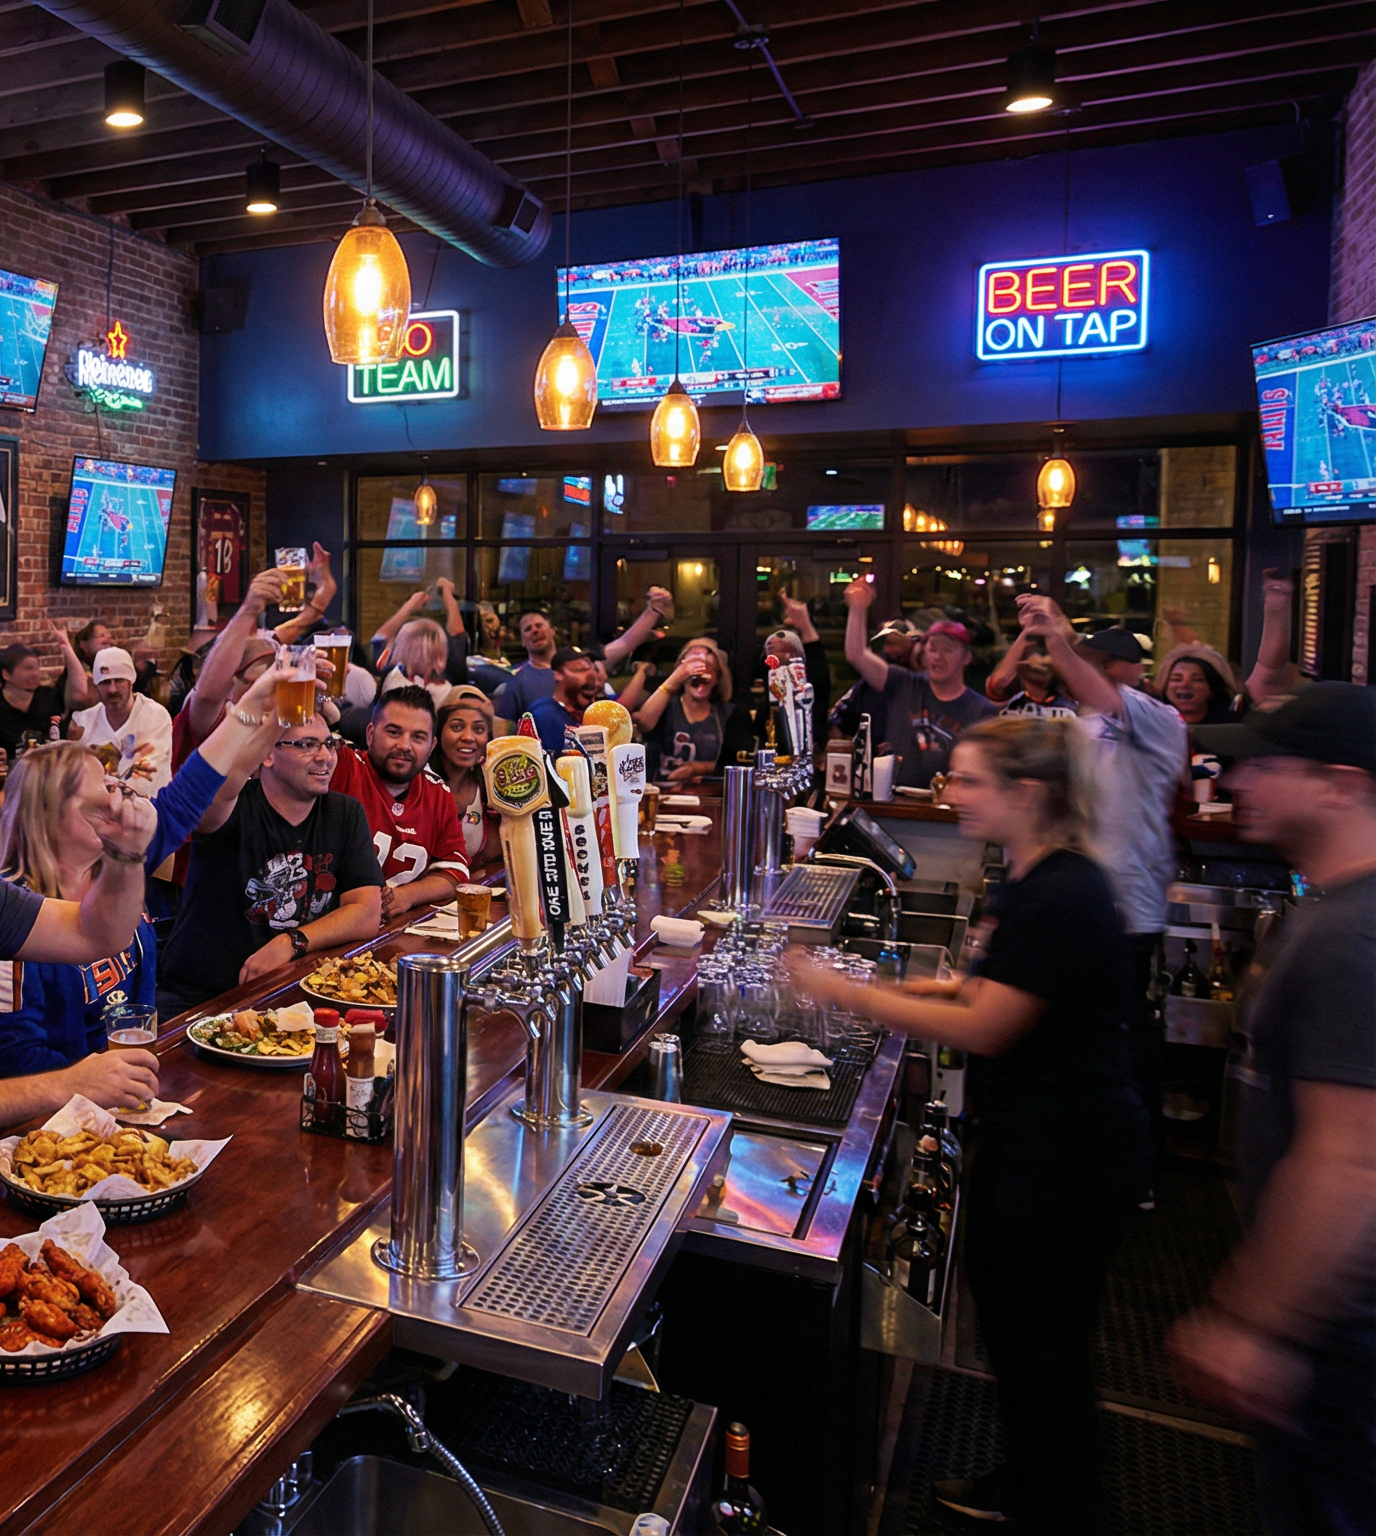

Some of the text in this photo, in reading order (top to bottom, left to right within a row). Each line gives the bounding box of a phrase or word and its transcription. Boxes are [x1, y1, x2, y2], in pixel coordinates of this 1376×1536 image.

[986, 260, 1138, 314] BEER
[985, 309, 1138, 352] ON TAP
[355, 356, 451, 395] TEAM
[215, 538, 234, 574] 18
